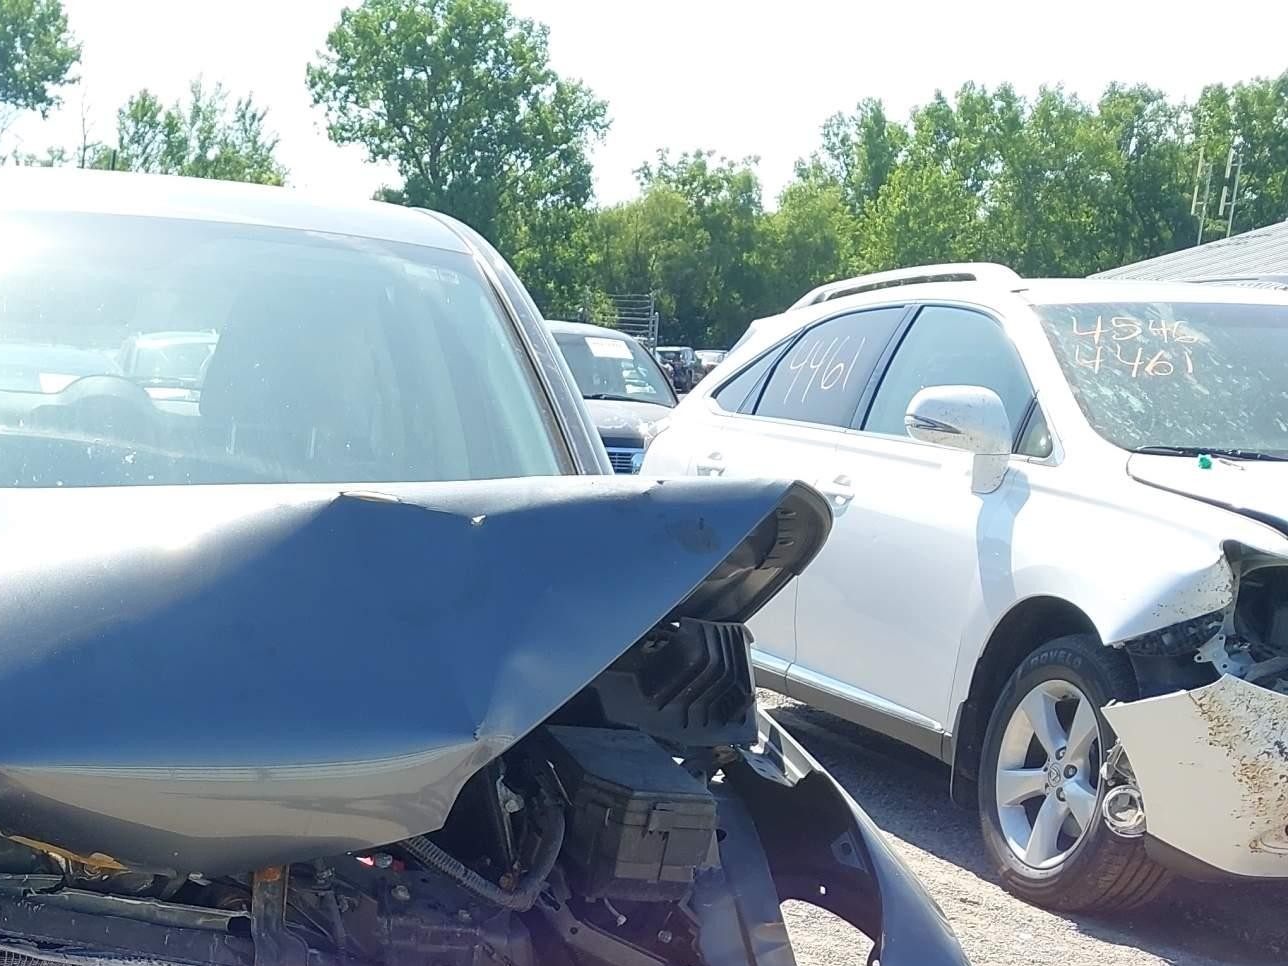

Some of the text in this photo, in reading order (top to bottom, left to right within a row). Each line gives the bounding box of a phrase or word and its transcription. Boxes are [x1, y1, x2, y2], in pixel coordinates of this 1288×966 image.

[1072, 315, 1199, 344] 4546
[783, 336, 866, 404] 4461
[1075, 343, 1193, 378] 4461
